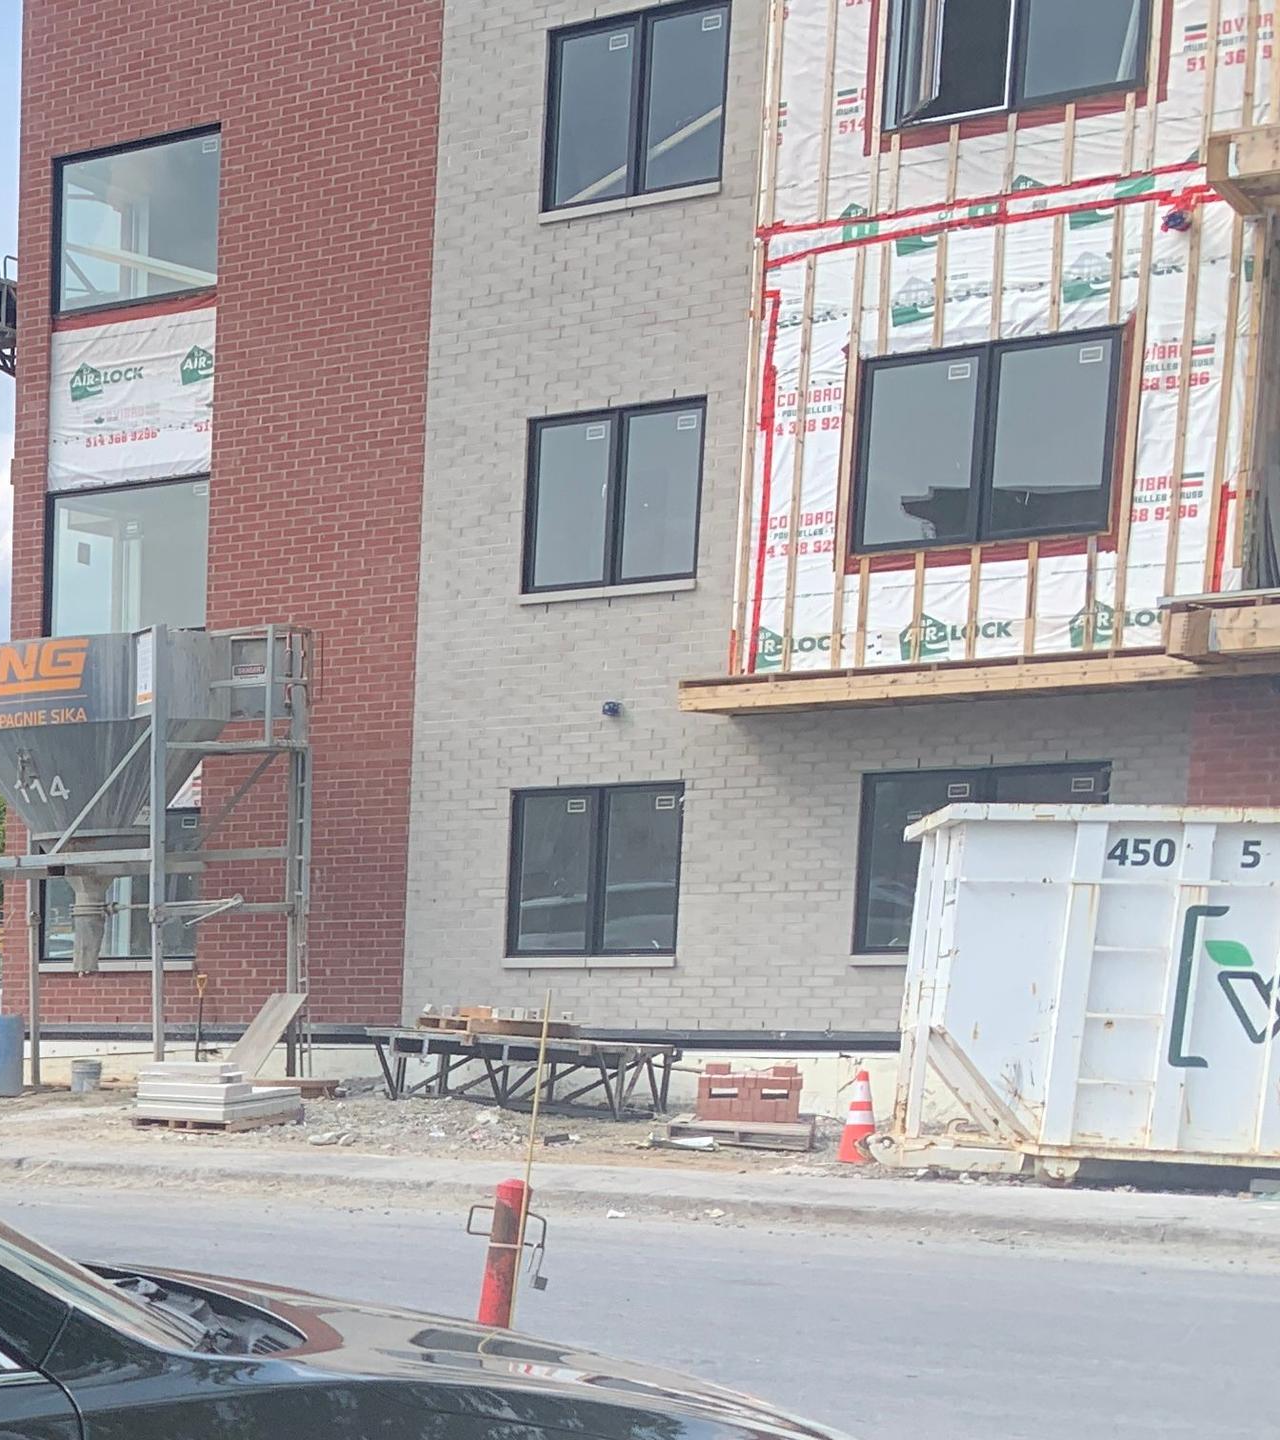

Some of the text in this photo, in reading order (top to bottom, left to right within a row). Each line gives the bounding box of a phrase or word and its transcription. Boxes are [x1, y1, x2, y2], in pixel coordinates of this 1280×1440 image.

[1186, 56, 1206, 72] 51
[1224, 49, 1246, 66] 36
[71, 366, 145, 388] AIR-LOCK
[50, 706, 88, 725] SIKA
[13, 775, 71, 804] 114
[1107, 837, 1176, 868] 450
